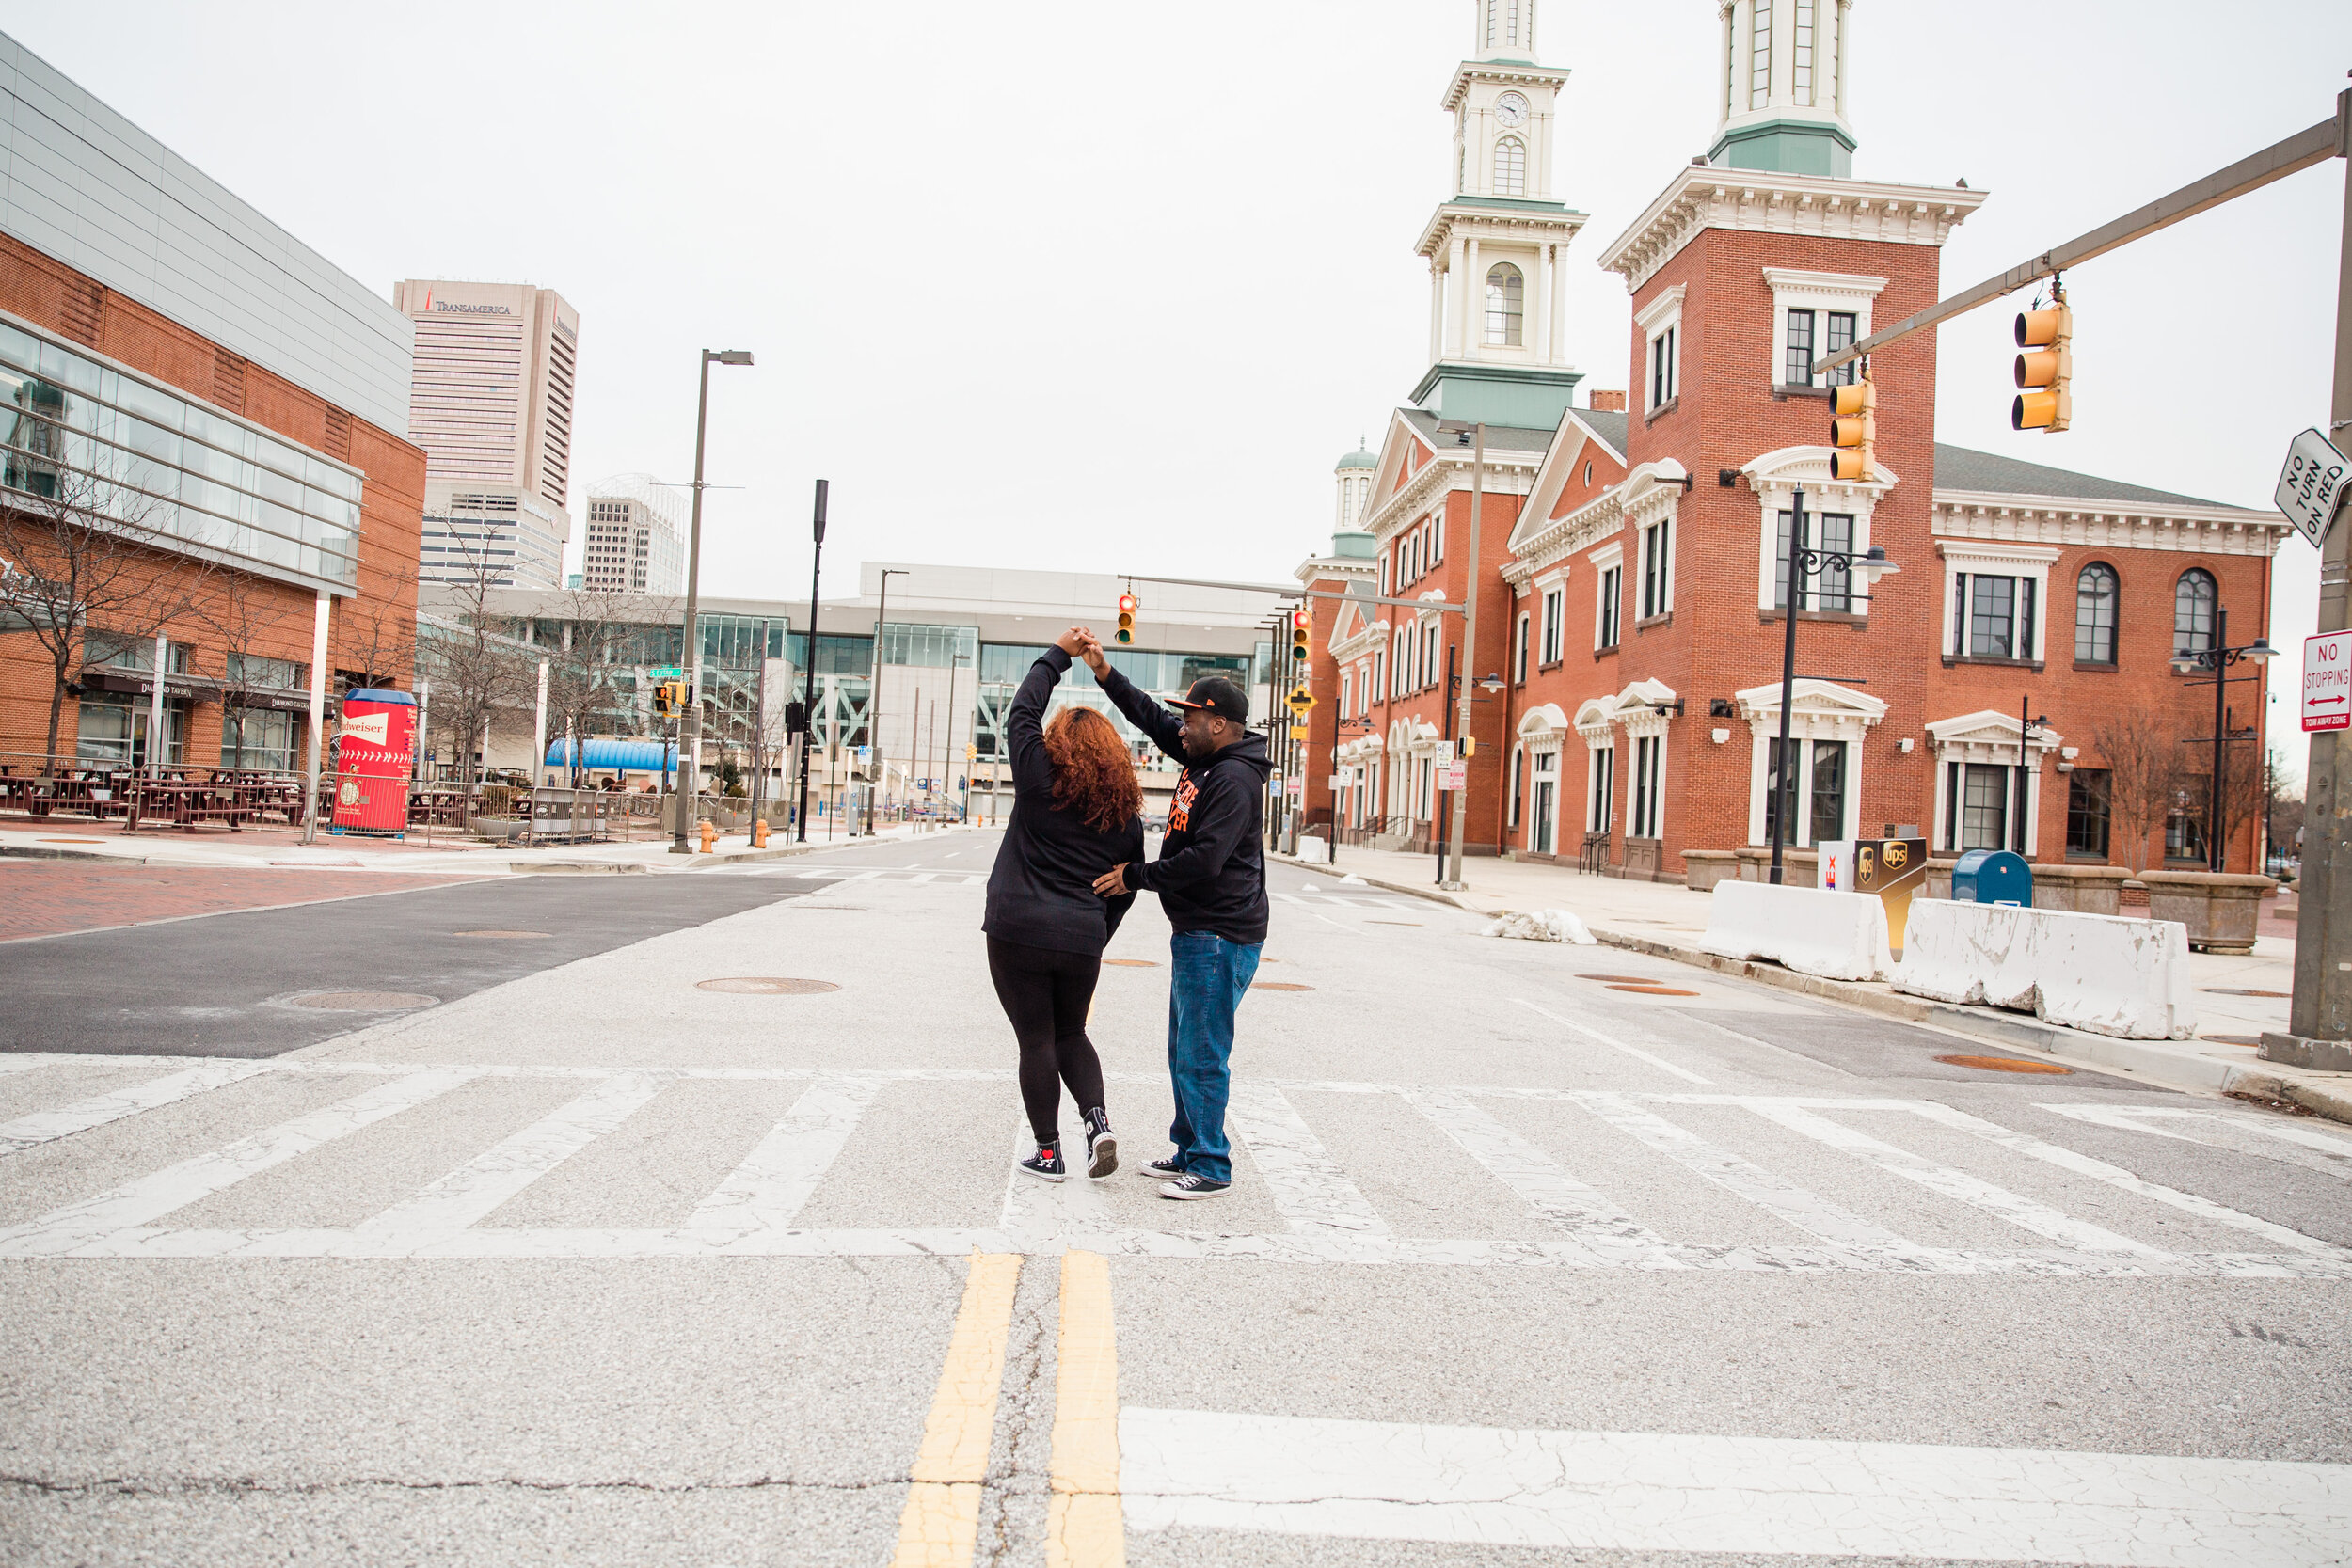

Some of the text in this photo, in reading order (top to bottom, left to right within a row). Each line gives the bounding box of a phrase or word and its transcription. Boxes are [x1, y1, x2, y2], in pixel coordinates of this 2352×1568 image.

[436, 301, 511, 315] TRANSAMERICA
[2286, 455, 2304, 489] NO
[2296, 459, 2322, 510] TURN
[2307, 466, 2344, 534] ON RED
[2318, 643, 2338, 662] NO
[141, 683, 170, 694] DIAND
[2306, 669, 2349, 689] STOPPING
[2332, 715, 2347, 724] ZONE
[1885, 849, 1906, 865] ups
[1860, 858, 1873, 879] ups
